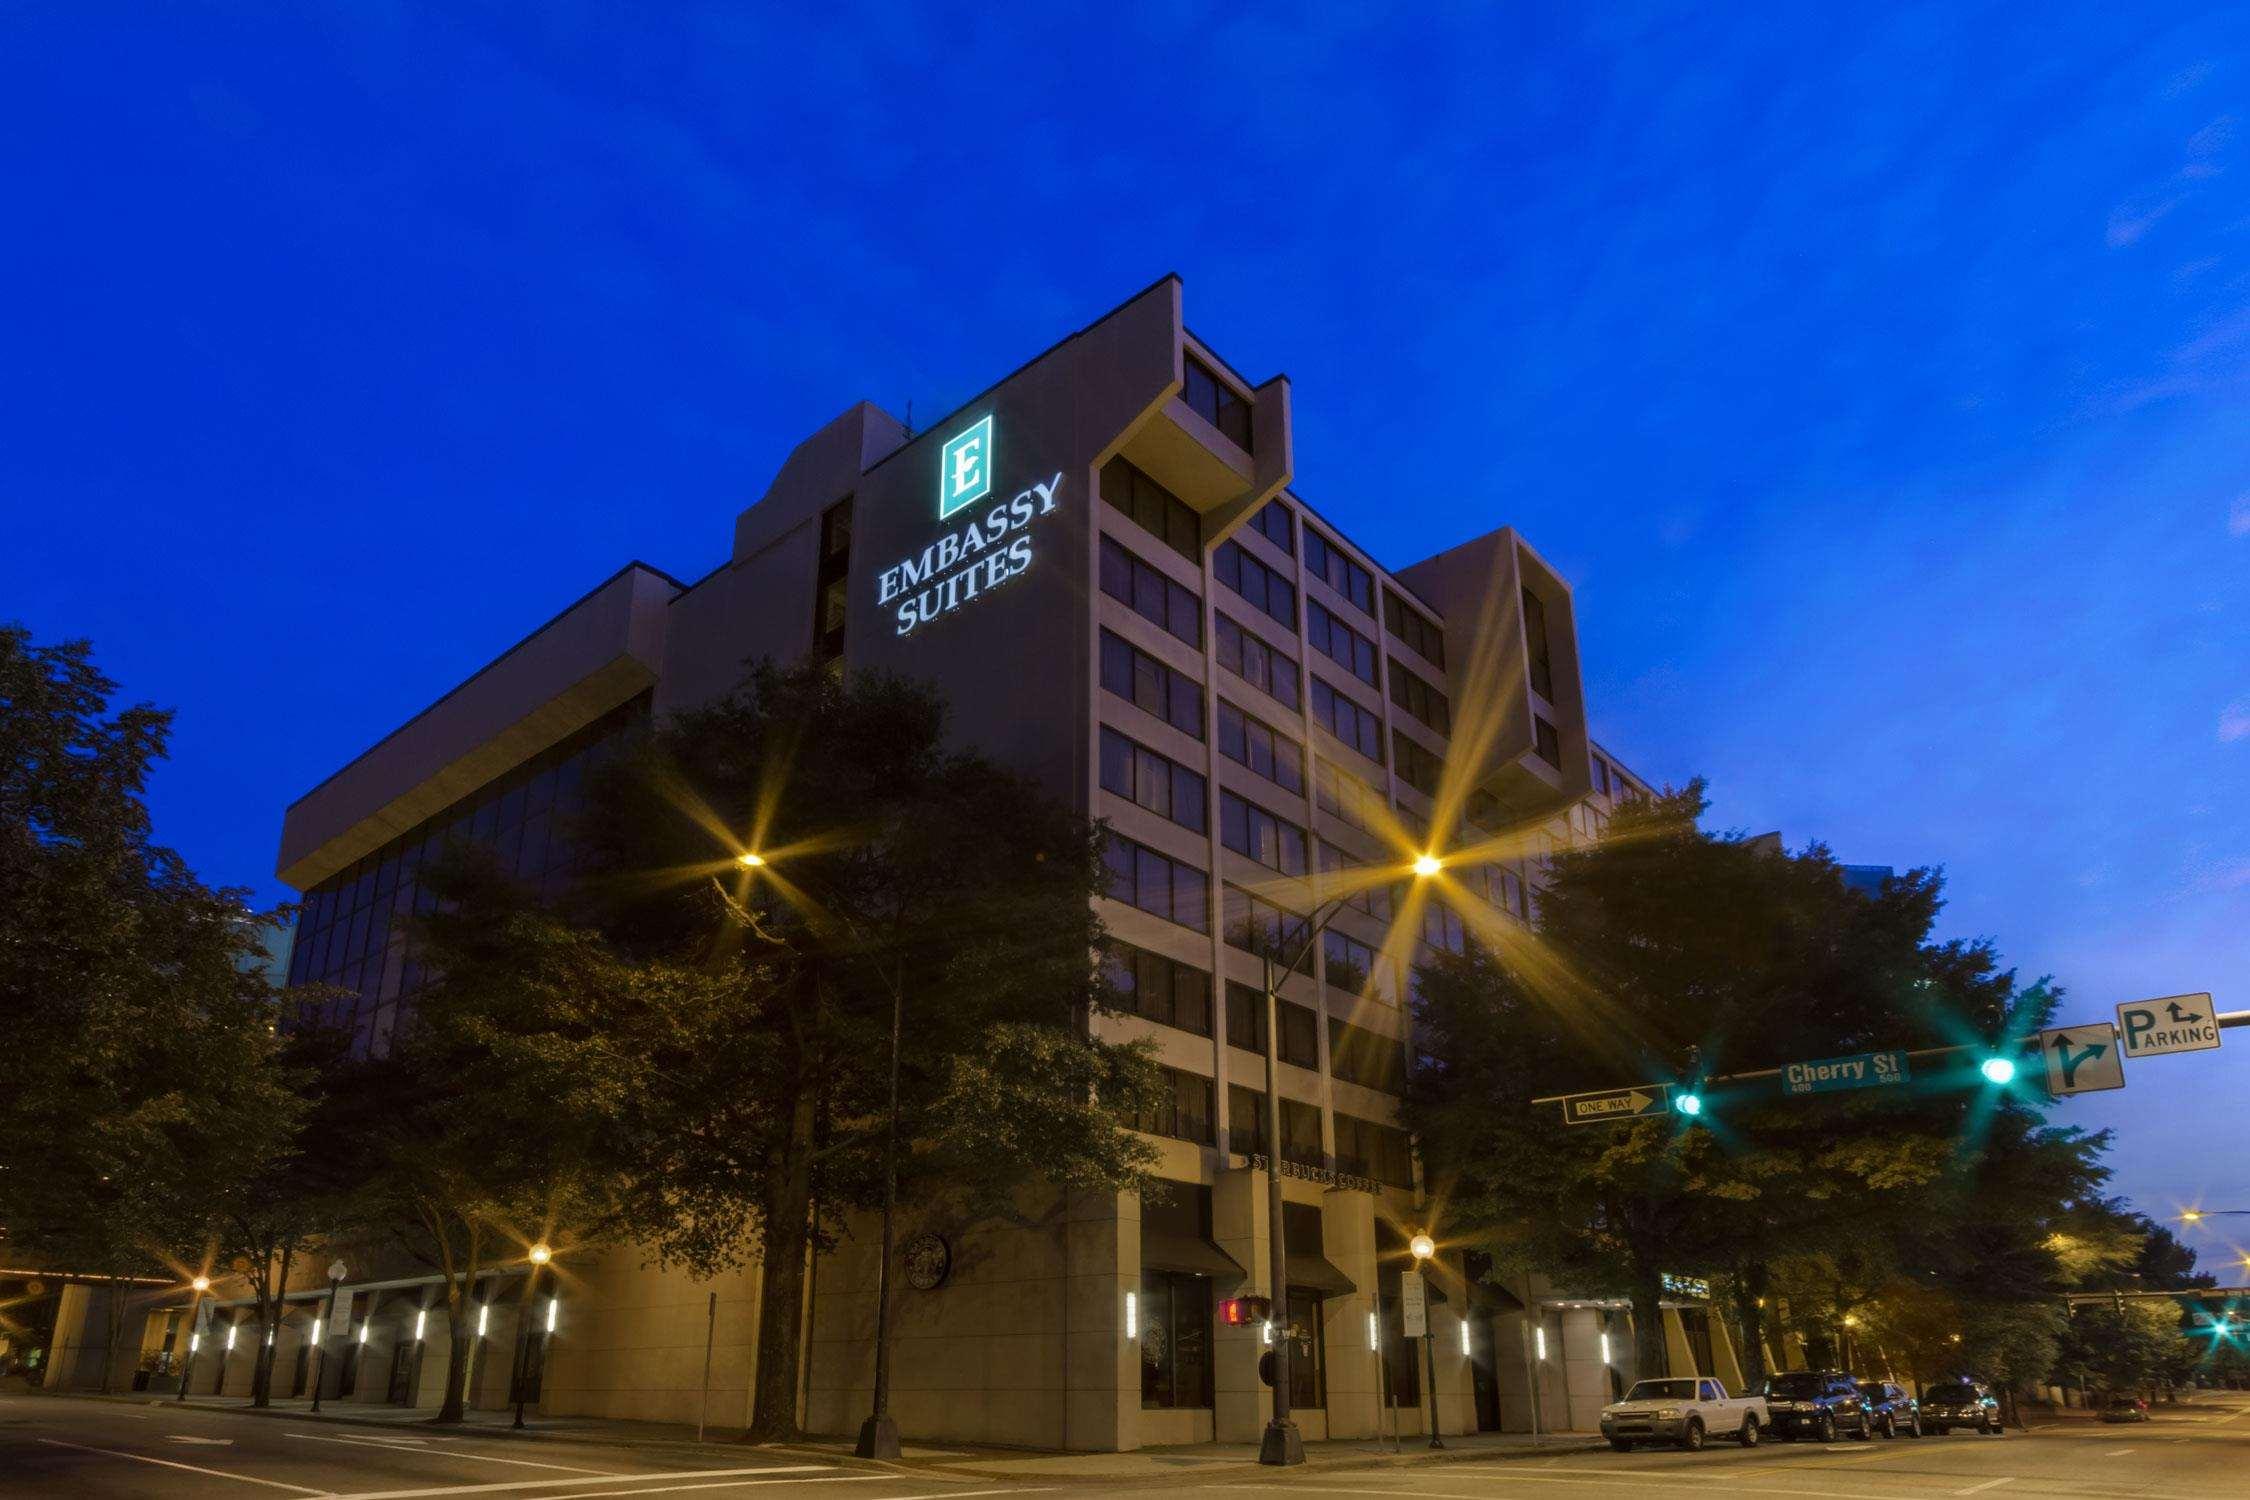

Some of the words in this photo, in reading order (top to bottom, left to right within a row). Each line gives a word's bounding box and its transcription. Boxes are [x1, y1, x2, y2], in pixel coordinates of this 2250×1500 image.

[952, 438, 980, 497] E
[878, 471, 1063, 606] EMBASSY
[897, 535, 1033, 636] SUITES
[2123, 1009, 2215, 1049] PARKING
[1787, 1060, 1865, 1084] Cherry
[1872, 1054, 1898, 1074] St
[1579, 1101, 1604, 1114] ONE
[1607, 1097, 1632, 1110] WAY
[1252, 1153, 1337, 1185] STRBUCKS
